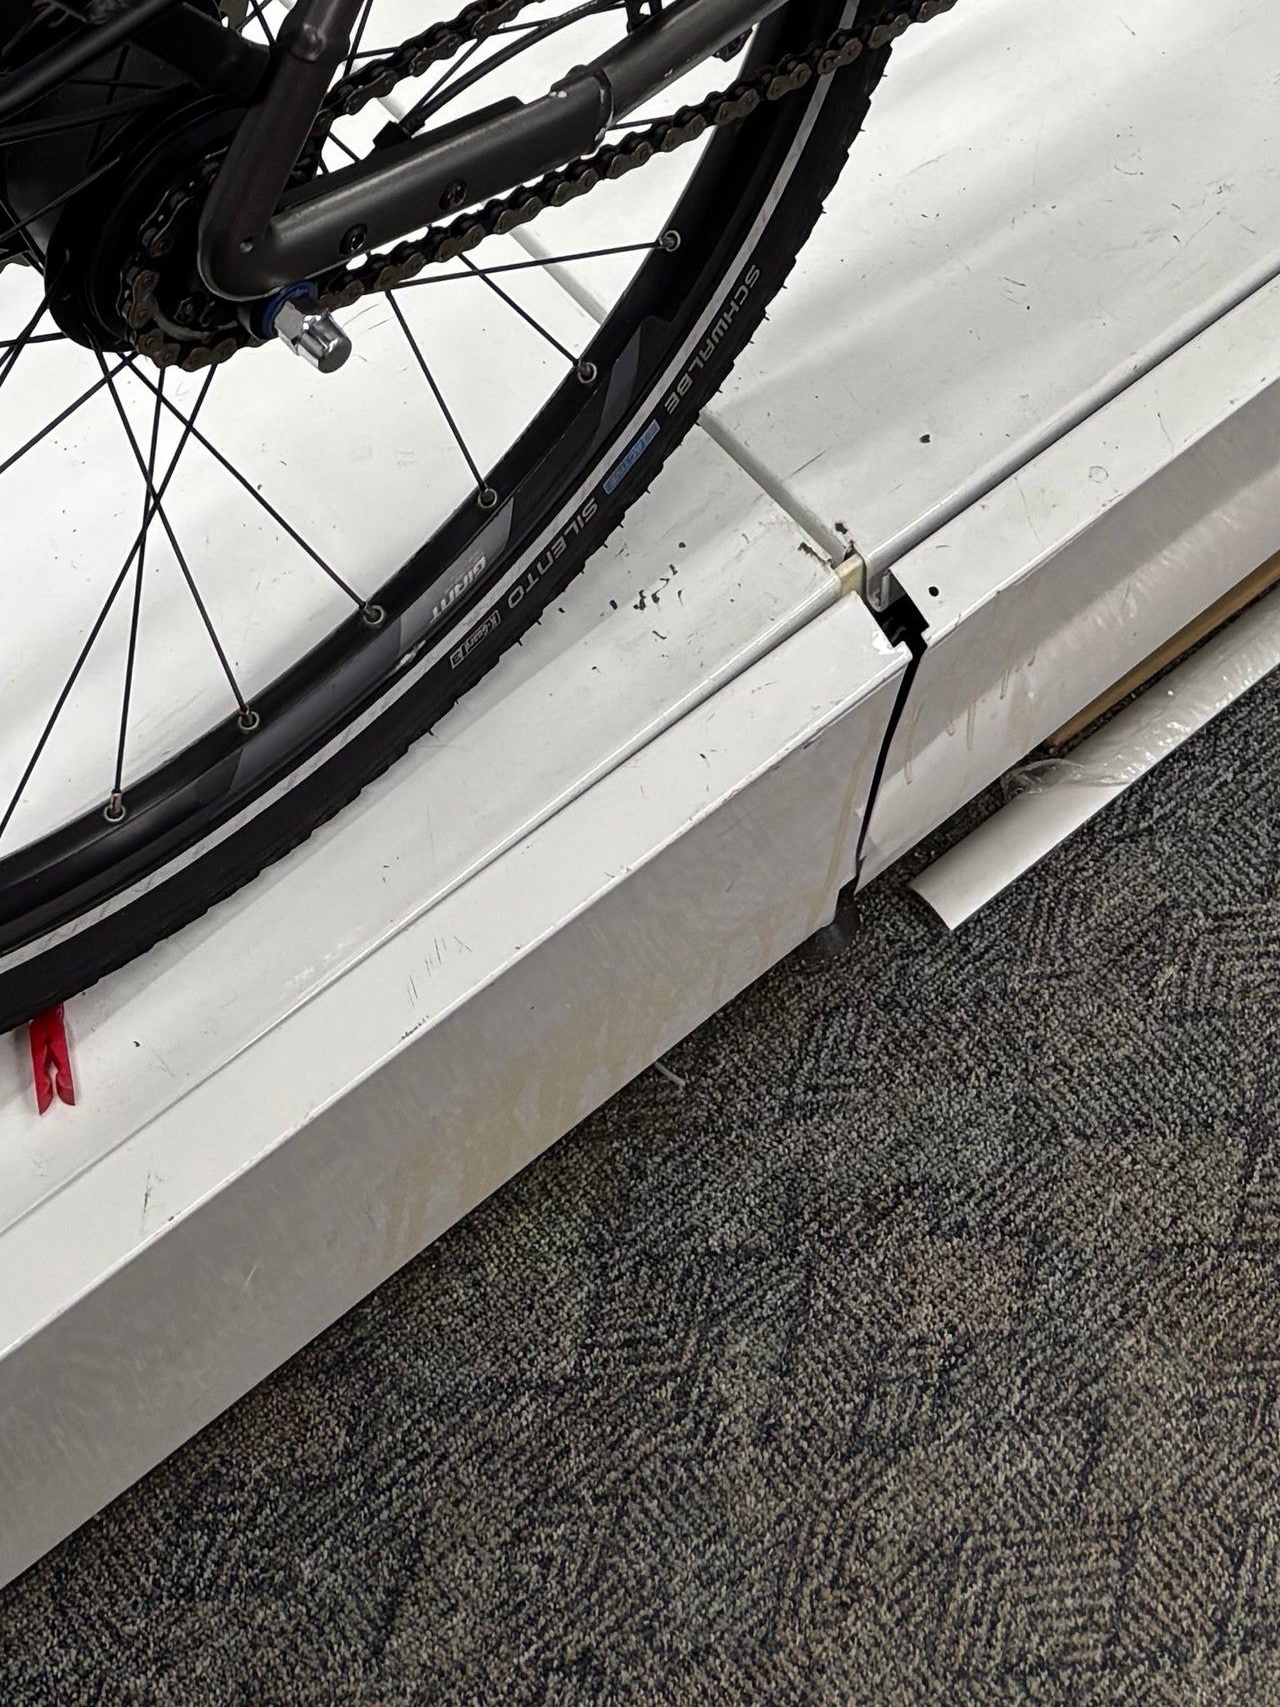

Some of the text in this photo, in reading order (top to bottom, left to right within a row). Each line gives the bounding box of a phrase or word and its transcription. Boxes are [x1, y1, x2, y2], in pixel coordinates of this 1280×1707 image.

[665, 264, 761, 414] SCHWALBE
[429, 555, 486, 624] GIANT
[507, 500, 599, 609] SILENTO
